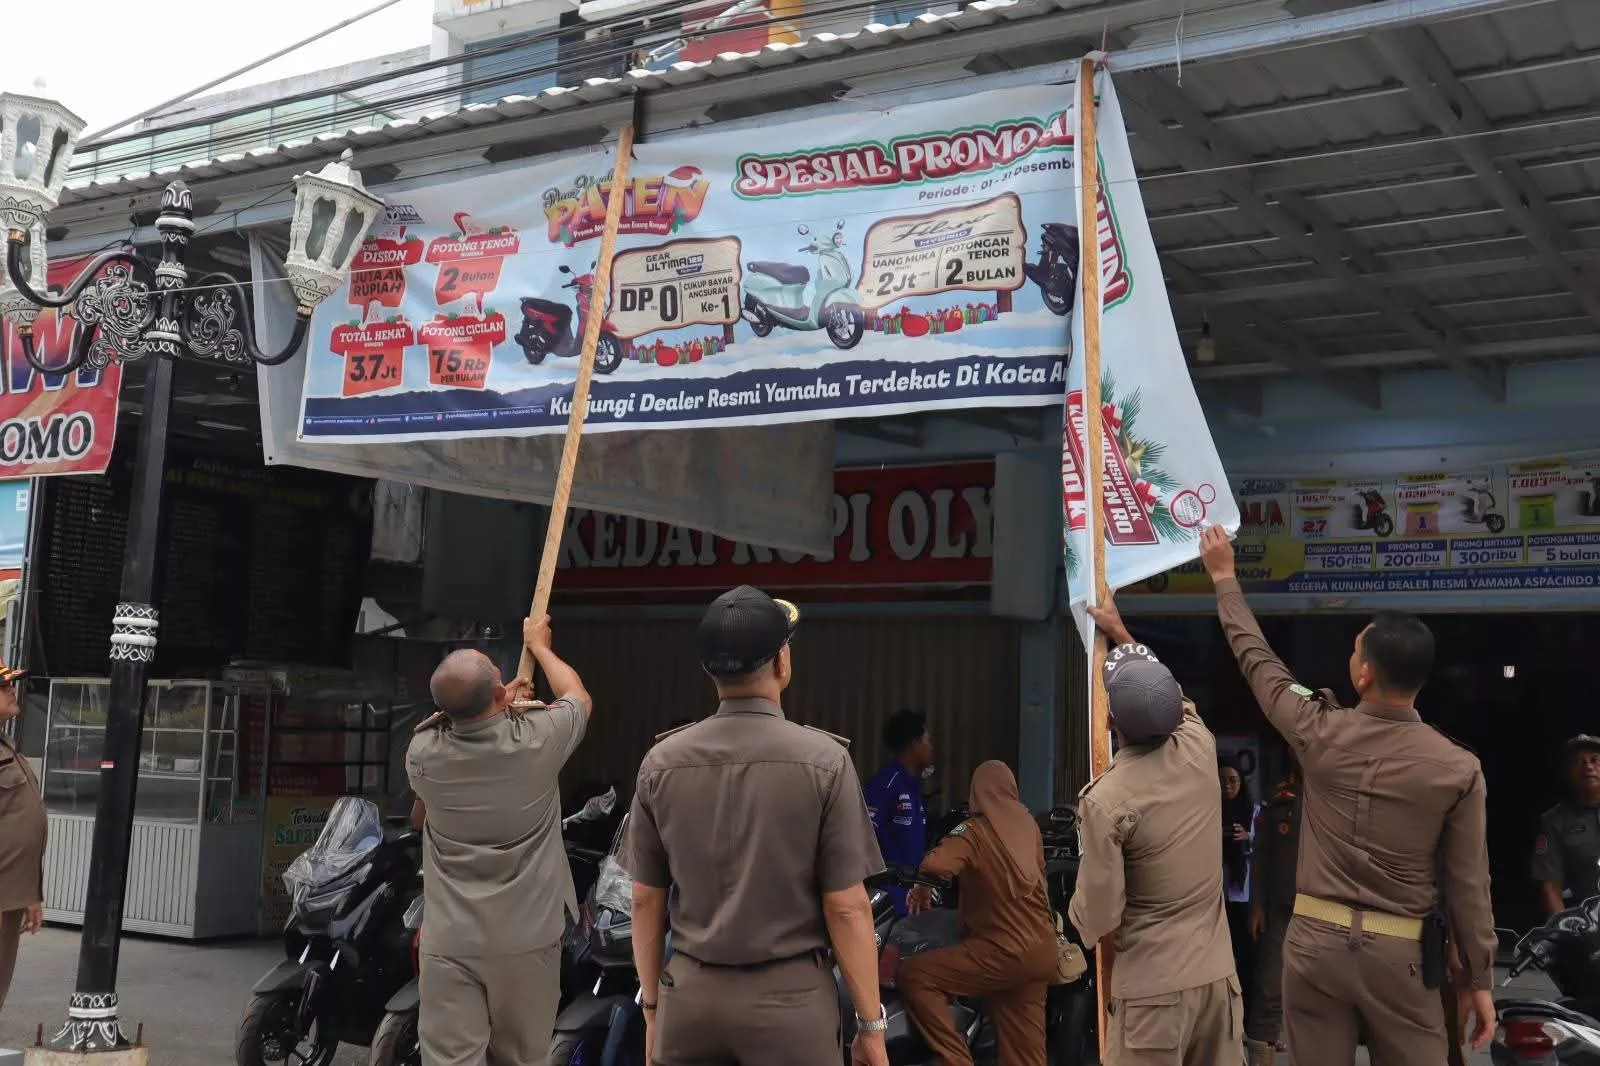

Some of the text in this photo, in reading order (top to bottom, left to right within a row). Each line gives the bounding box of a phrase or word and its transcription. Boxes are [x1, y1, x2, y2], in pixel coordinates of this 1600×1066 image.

[739, 128, 1038, 190] SPESIAL PROMO
[919, 185, 968, 201] Periode
[432, 237, 515, 254] POTONG TENOR
[945, 237, 1010, 254] POTONGAN
[646, 252, 670, 263] GEAR
[873, 251, 936, 268] UANG MUKA
[967, 248, 1010, 260] TENOR
[646, 257, 687, 272] ULTIMA
[945, 258, 1016, 286] 2 BULAN
[440, 267, 460, 292] 2
[684, 276, 733, 290] CUKUP BAYAR
[354, 282, 402, 297] RUPIAH
[688, 286, 728, 299] ANGSURAN
[620, 287, 653, 312] DP
[659, 285, 679, 322] 0
[340, 328, 406, 343] TOTAL HEMAT
[422, 321, 504, 337] POTONG CICILAN
[431, 350, 464, 374] 75
[549, 392, 636, 419] Kujungi
[639, 390, 705, 412] Dealer
[707, 383, 762, 408] Resmi
[765, 376, 841, 403] Yamaha
[845, 369, 951, 396] Terdekat
[955, 362, 980, 387] Di
[985, 362, 1047, 385] Kota
[1388, 543, 1420, 552] PROMO
[1453, 537, 1521, 549] PROMO BIRTHDAY
[1320, 554, 1371, 569] 150 ribu
[1383, 551, 1441, 568] 200 ribu
[1459, 549, 1517, 565] 300 ribu
[1545, 548, 1600, 562] 5 bulan
[1288, 582, 1328, 592] SEGERA
[1331, 580, 1385, 592] KUNJUNGI
[1387, 580, 1429, 591] DEALER
[1432, 578, 1467, 590] RESMI
[1470, 577, 1521, 589] YAMAHA
[1523, 574, 1594, 588] ASPACINDO
